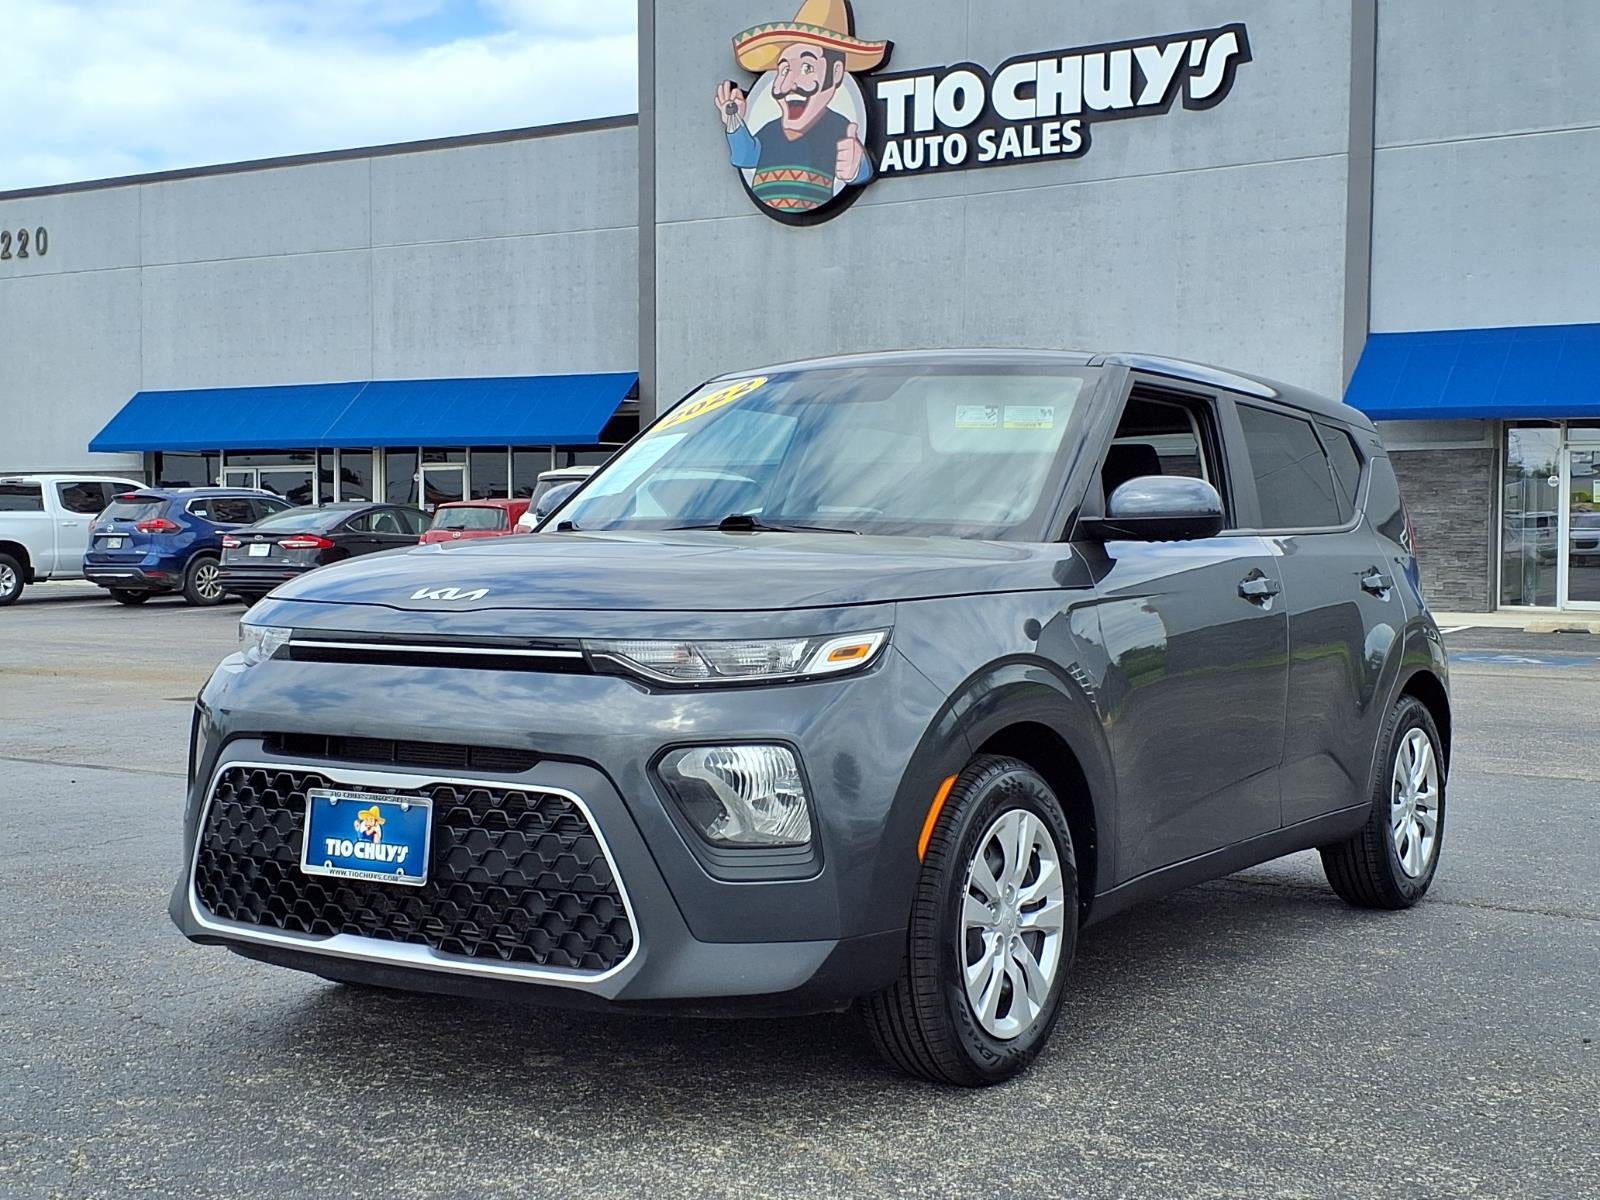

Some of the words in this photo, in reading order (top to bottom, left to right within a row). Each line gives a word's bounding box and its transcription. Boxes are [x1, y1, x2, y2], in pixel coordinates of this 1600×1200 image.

[877, 70, 985, 135] TIO
[991, 32, 1239, 120] CHUY'S
[879, 135, 967, 172] AUTO
[977, 119, 1082, 162] SALES
[0, 226, 48, 260] 220
[662, 379, 756, 428] 2022
[410, 587, 490, 600] KIA
[326, 838, 354, 857] TIO
[354, 841, 409, 863] CHUY'S
